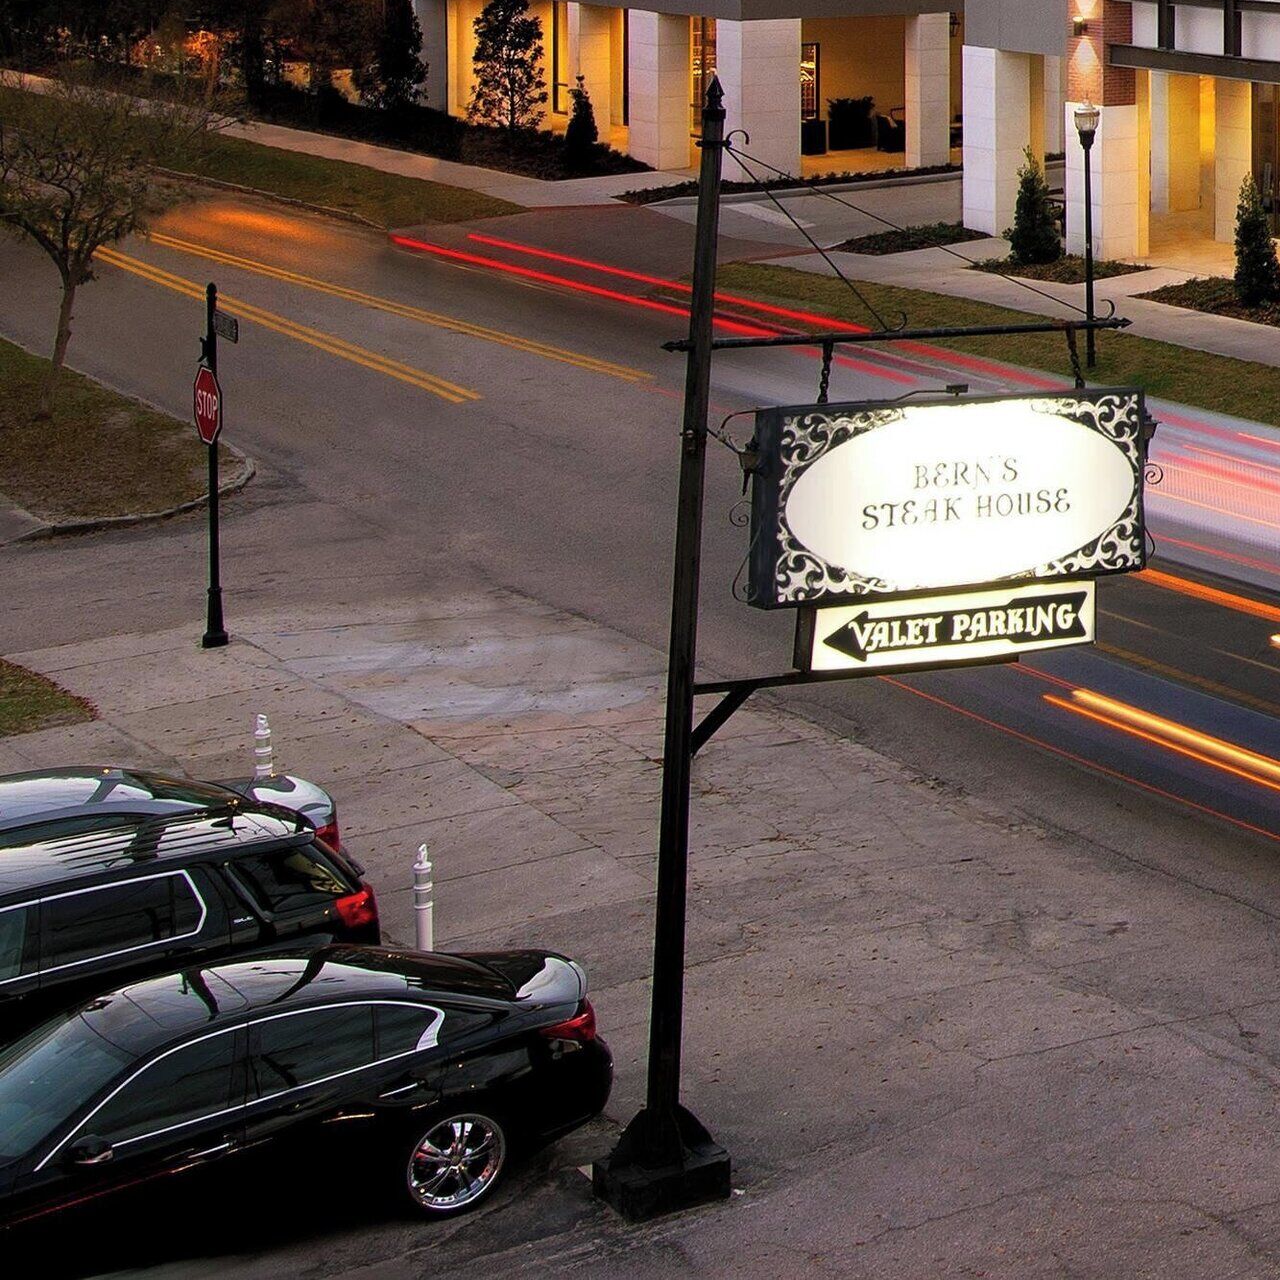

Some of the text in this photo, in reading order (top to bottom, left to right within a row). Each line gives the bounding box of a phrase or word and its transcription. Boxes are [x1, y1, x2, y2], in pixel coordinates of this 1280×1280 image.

[196, 389, 218, 420] STOP
[913, 455, 1018, 490] BERN'S
[861, 487, 1071, 531] STEAK HOUSE
[849, 602, 1077, 652] VALET PARKING
